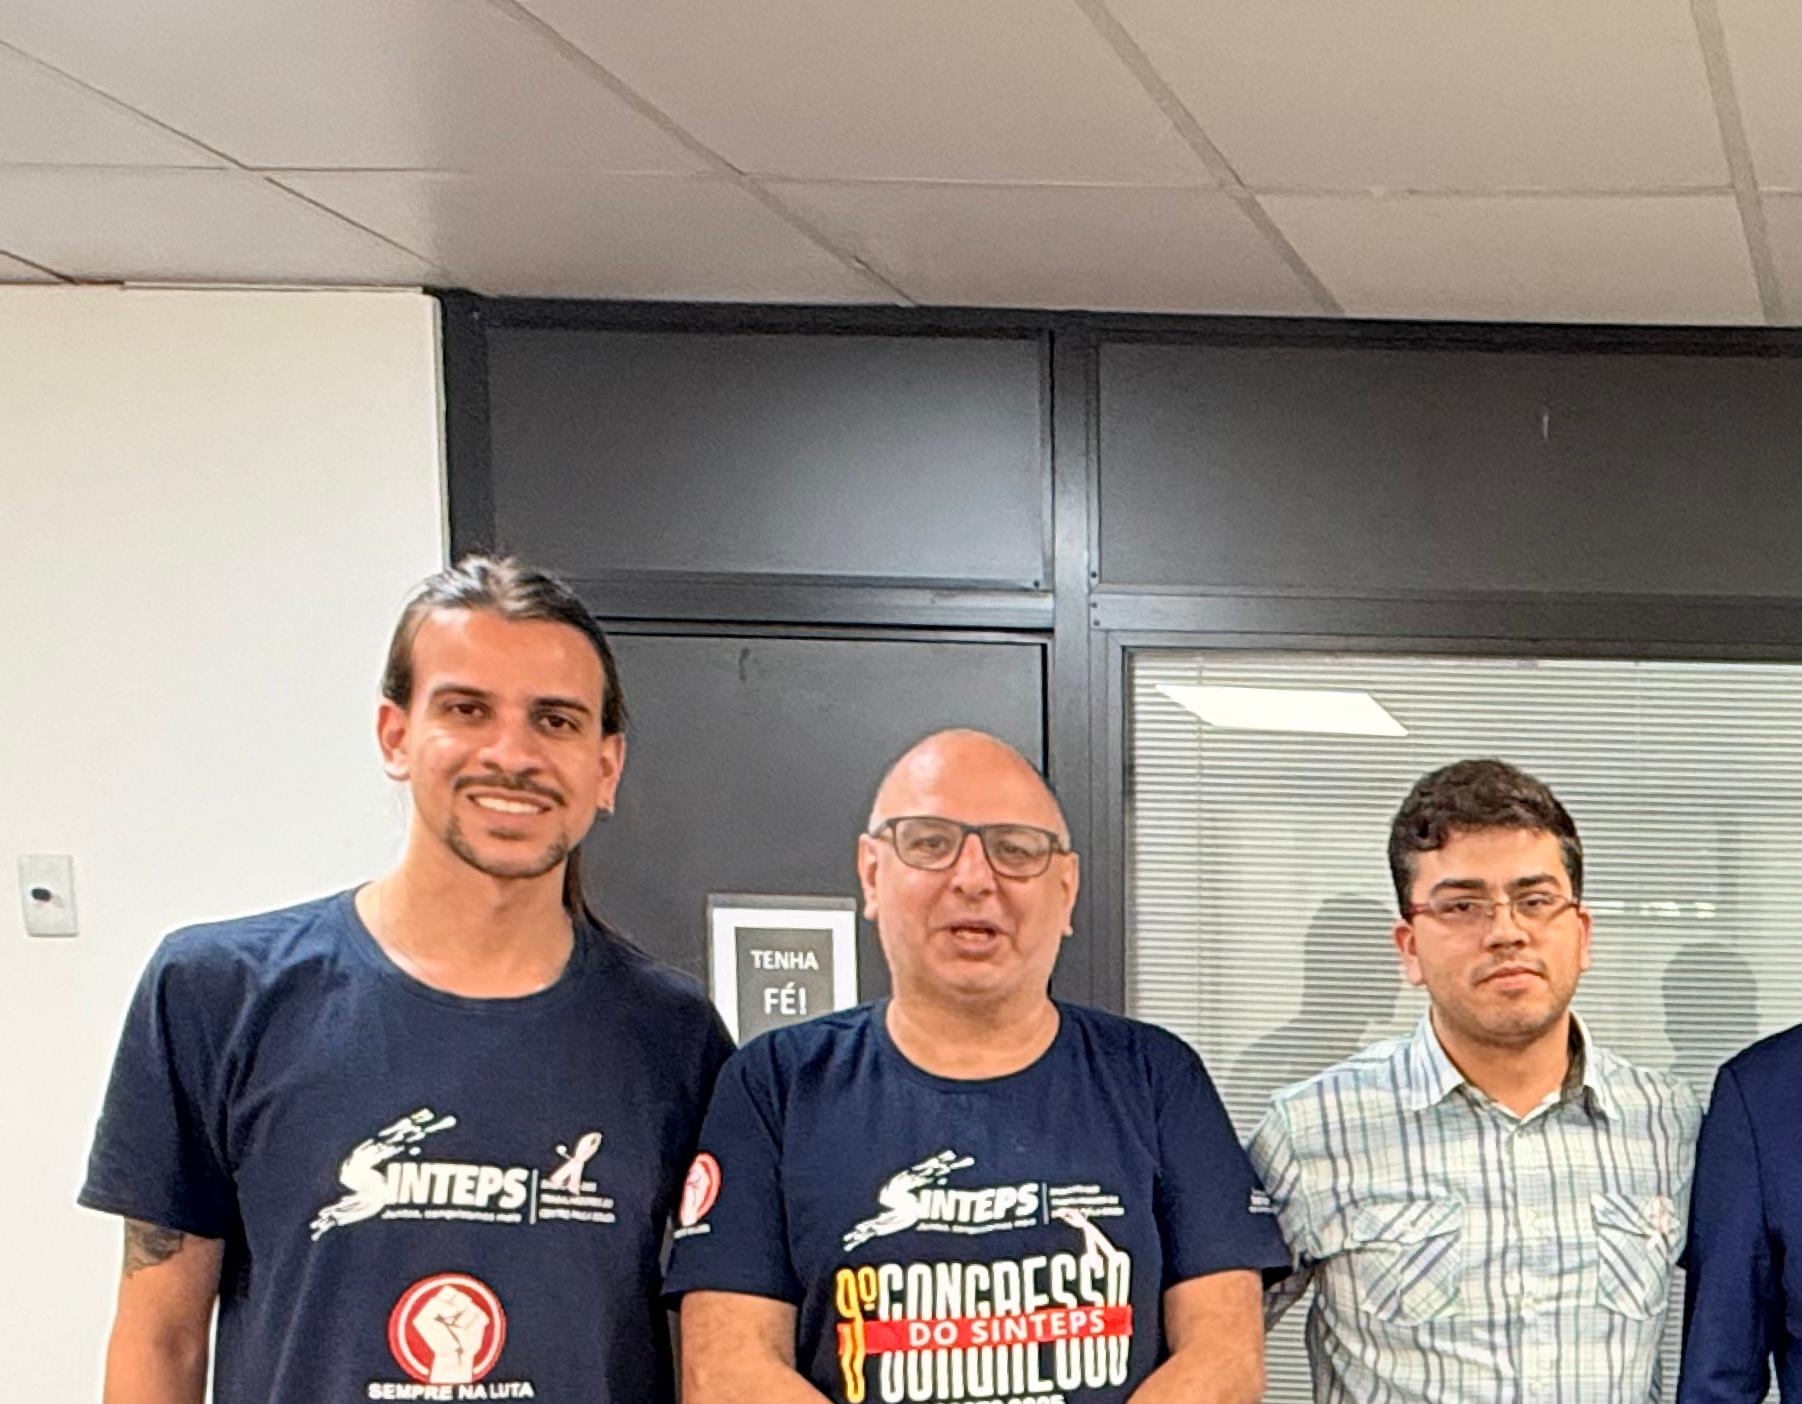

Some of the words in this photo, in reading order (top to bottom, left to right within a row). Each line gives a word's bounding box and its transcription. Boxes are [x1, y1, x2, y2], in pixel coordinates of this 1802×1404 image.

[750, 949, 819, 971] TENHA
[764, 981, 807, 1016] FÉ!
[310, 1108, 529, 1241] SINTEPS
[843, 1150, 1039, 1252] SINTEPS
[909, 1321, 958, 1347] DO
[971, 1309, 1105, 1343] SINTEPS
[368, 1383, 454, 1400] SEMPRE
[458, 1384, 488, 1399] NA
[489, 1382, 535, 1399] LUTA
